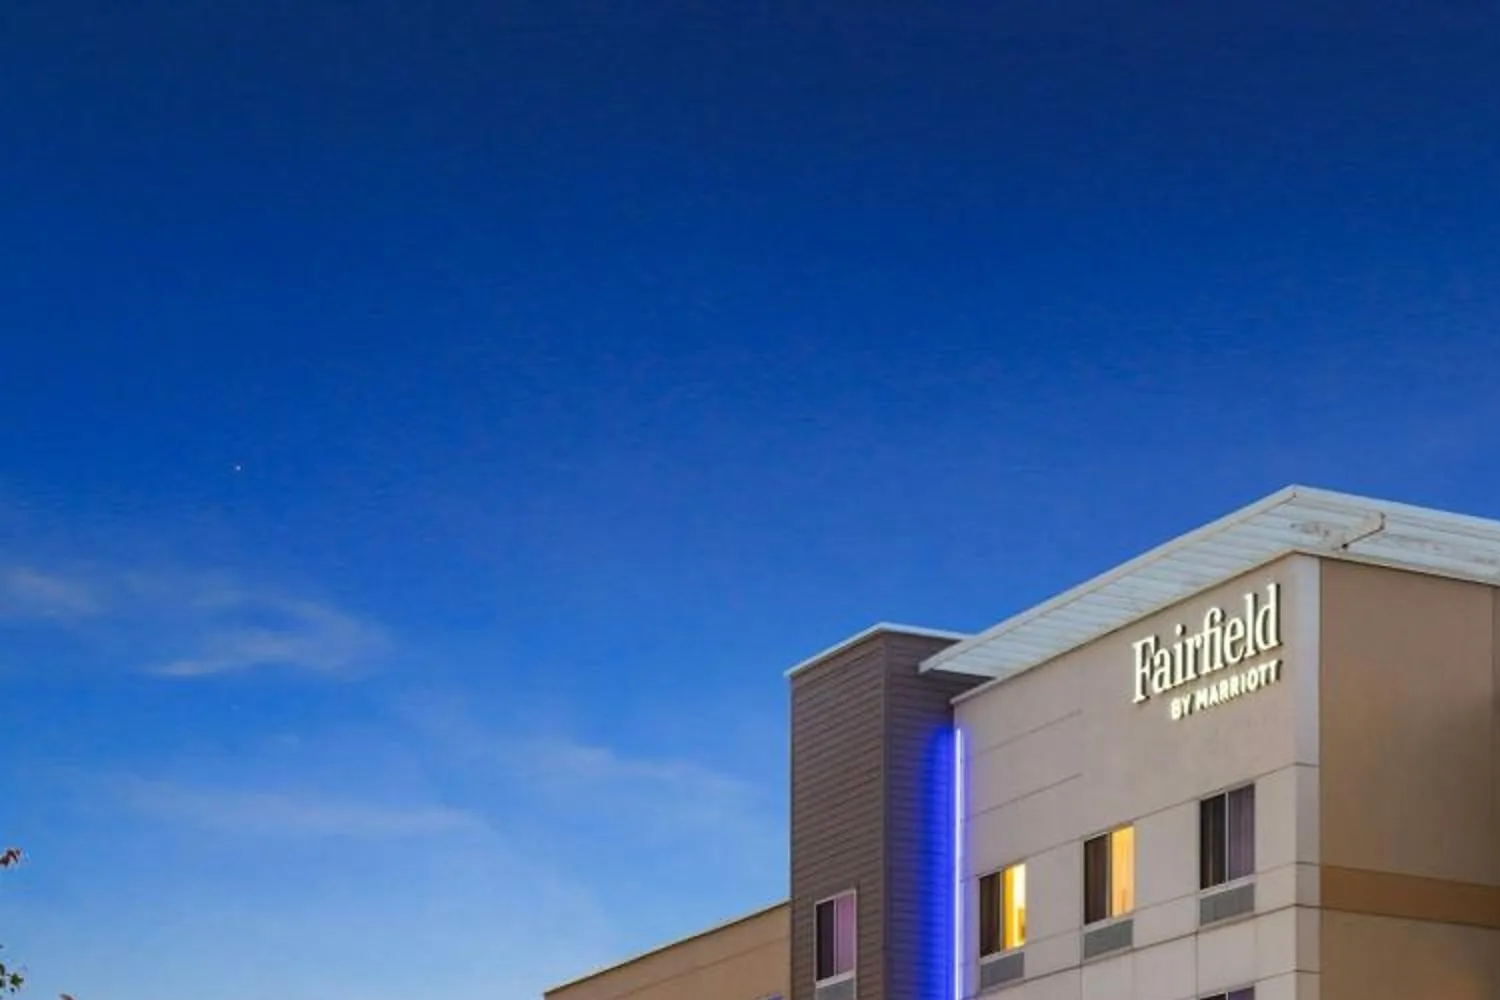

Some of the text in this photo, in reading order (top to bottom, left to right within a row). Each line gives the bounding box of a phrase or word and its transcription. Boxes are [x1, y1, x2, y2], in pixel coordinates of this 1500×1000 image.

[1132, 583, 1280, 703] Fairfield
[1171, 660, 1279, 720] BY MARRIOTT
